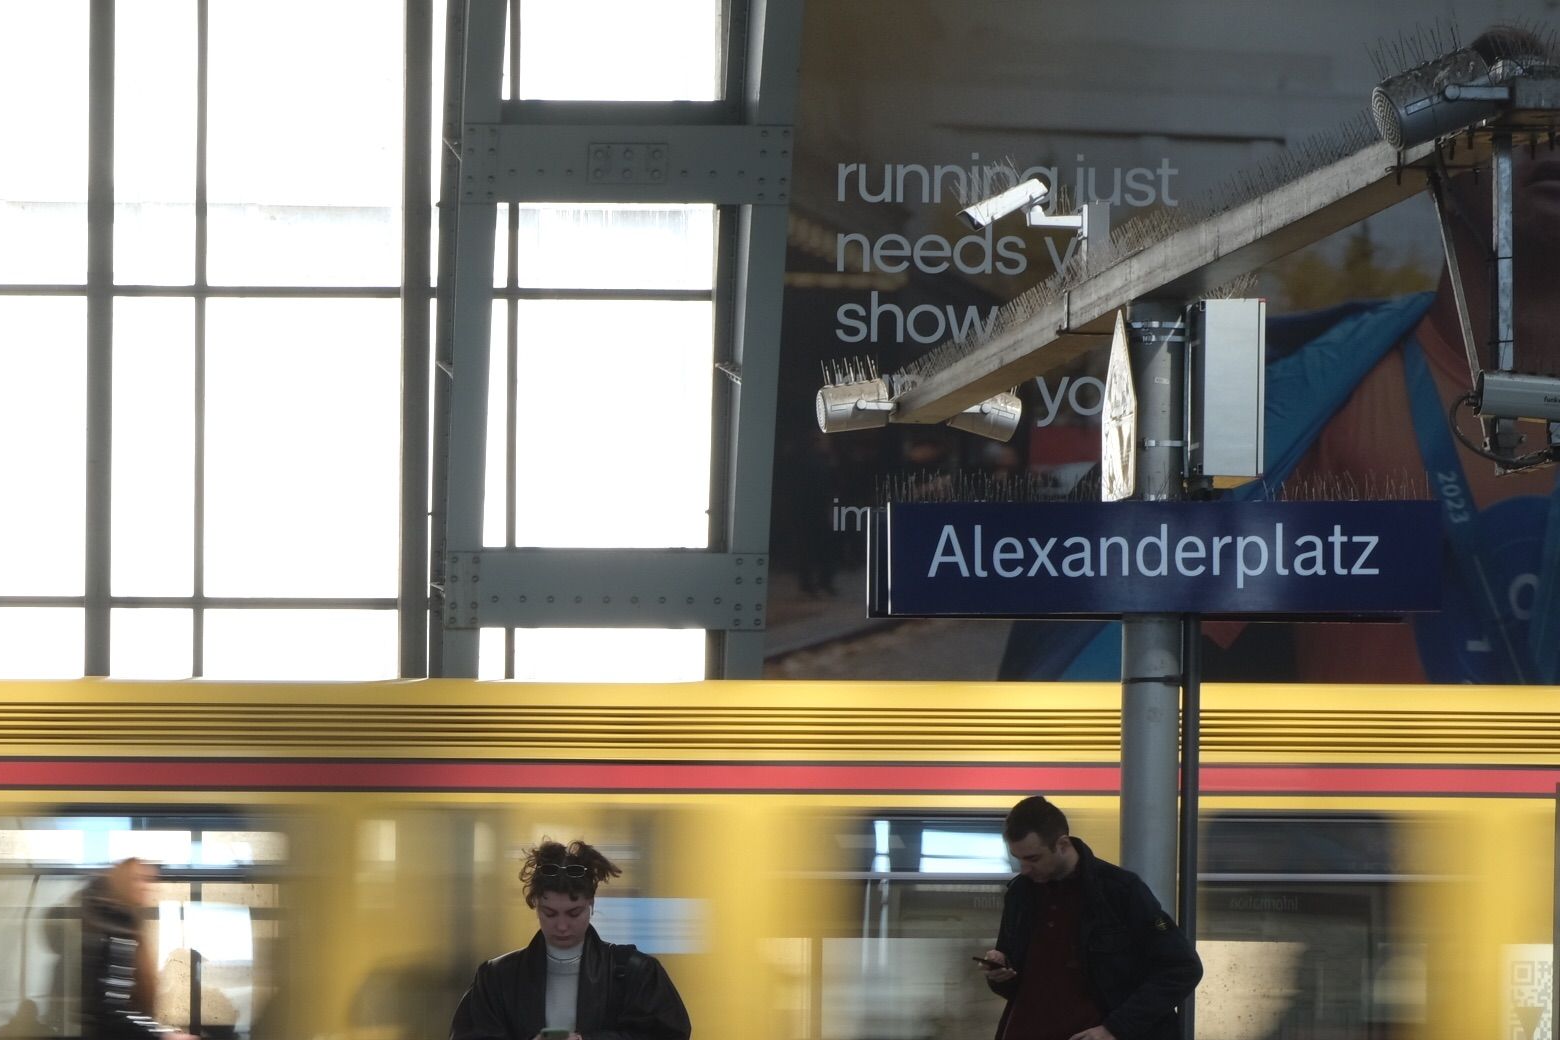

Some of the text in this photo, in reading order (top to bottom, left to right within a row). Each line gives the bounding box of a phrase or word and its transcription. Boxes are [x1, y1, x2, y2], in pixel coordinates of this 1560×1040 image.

[1072, 153, 1178, 214] just
[836, 222, 1028, 275] needs
[835, 291, 1000, 344] show
[1036, 375, 1105, 427] yo
[927, 522, 1380, 589] Alexanderplatz
